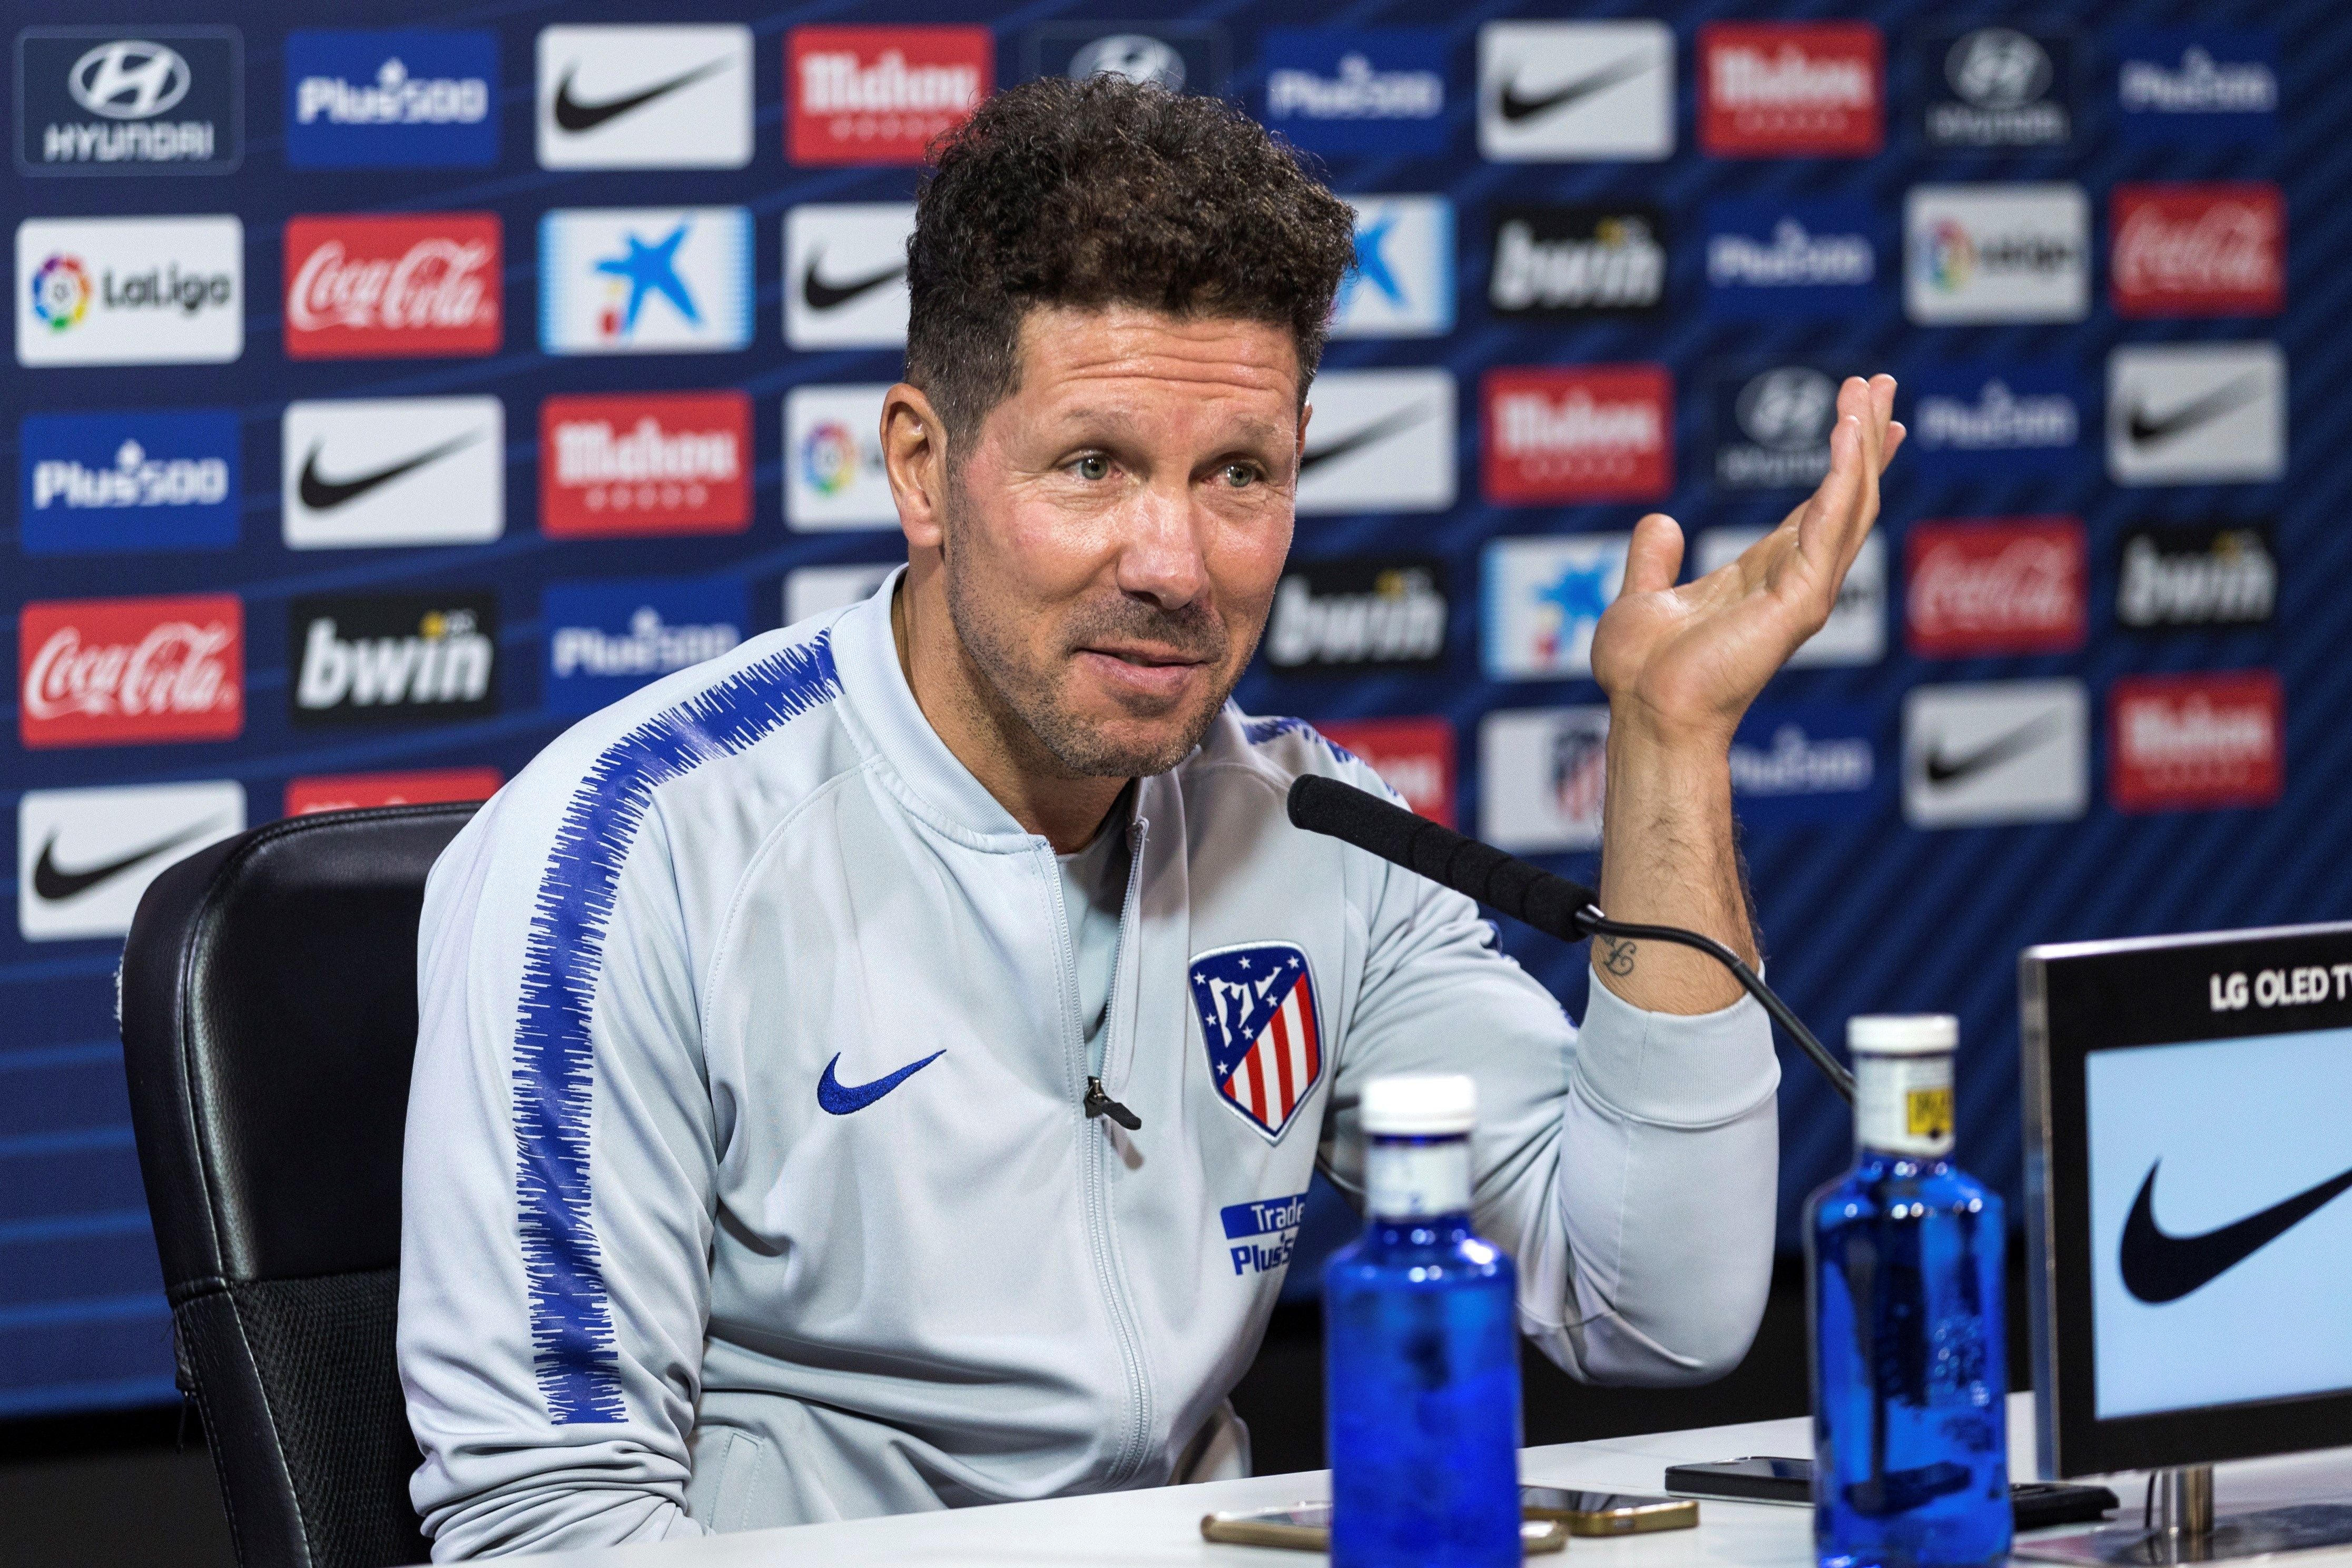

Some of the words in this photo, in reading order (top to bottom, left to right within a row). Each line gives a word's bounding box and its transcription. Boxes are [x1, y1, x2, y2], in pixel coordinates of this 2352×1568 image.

[297, 59, 488, 123] Plus500
[44, 122, 214, 161] HYUNDAI
[102, 266, 232, 317] LaLiga
[33, 439, 229, 508] Plus500
[298, 617, 493, 707] bwin
[2210, 971, 2249, 1012] LG
[2254, 968, 2329, 1008] OLED
